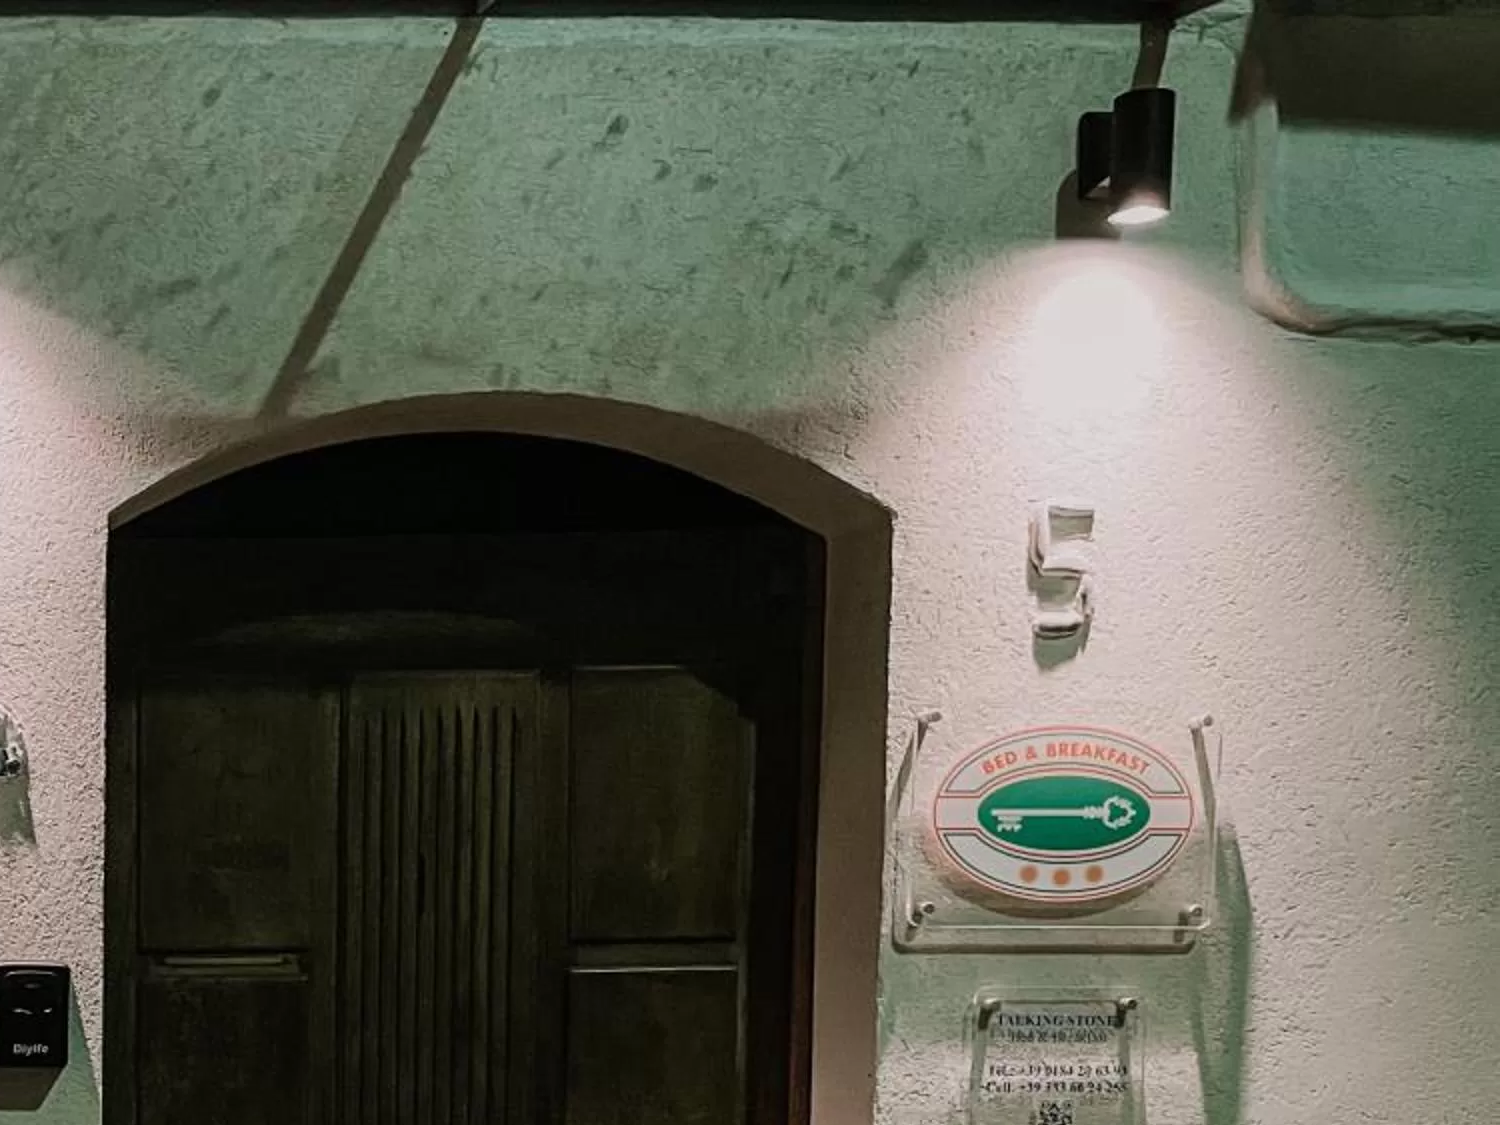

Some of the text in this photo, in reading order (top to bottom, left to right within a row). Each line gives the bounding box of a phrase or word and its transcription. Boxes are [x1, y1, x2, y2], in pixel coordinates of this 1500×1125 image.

[981, 742, 1150, 775] BED & BREAKFAST
[1067, 1014, 1121, 1026] STONE
